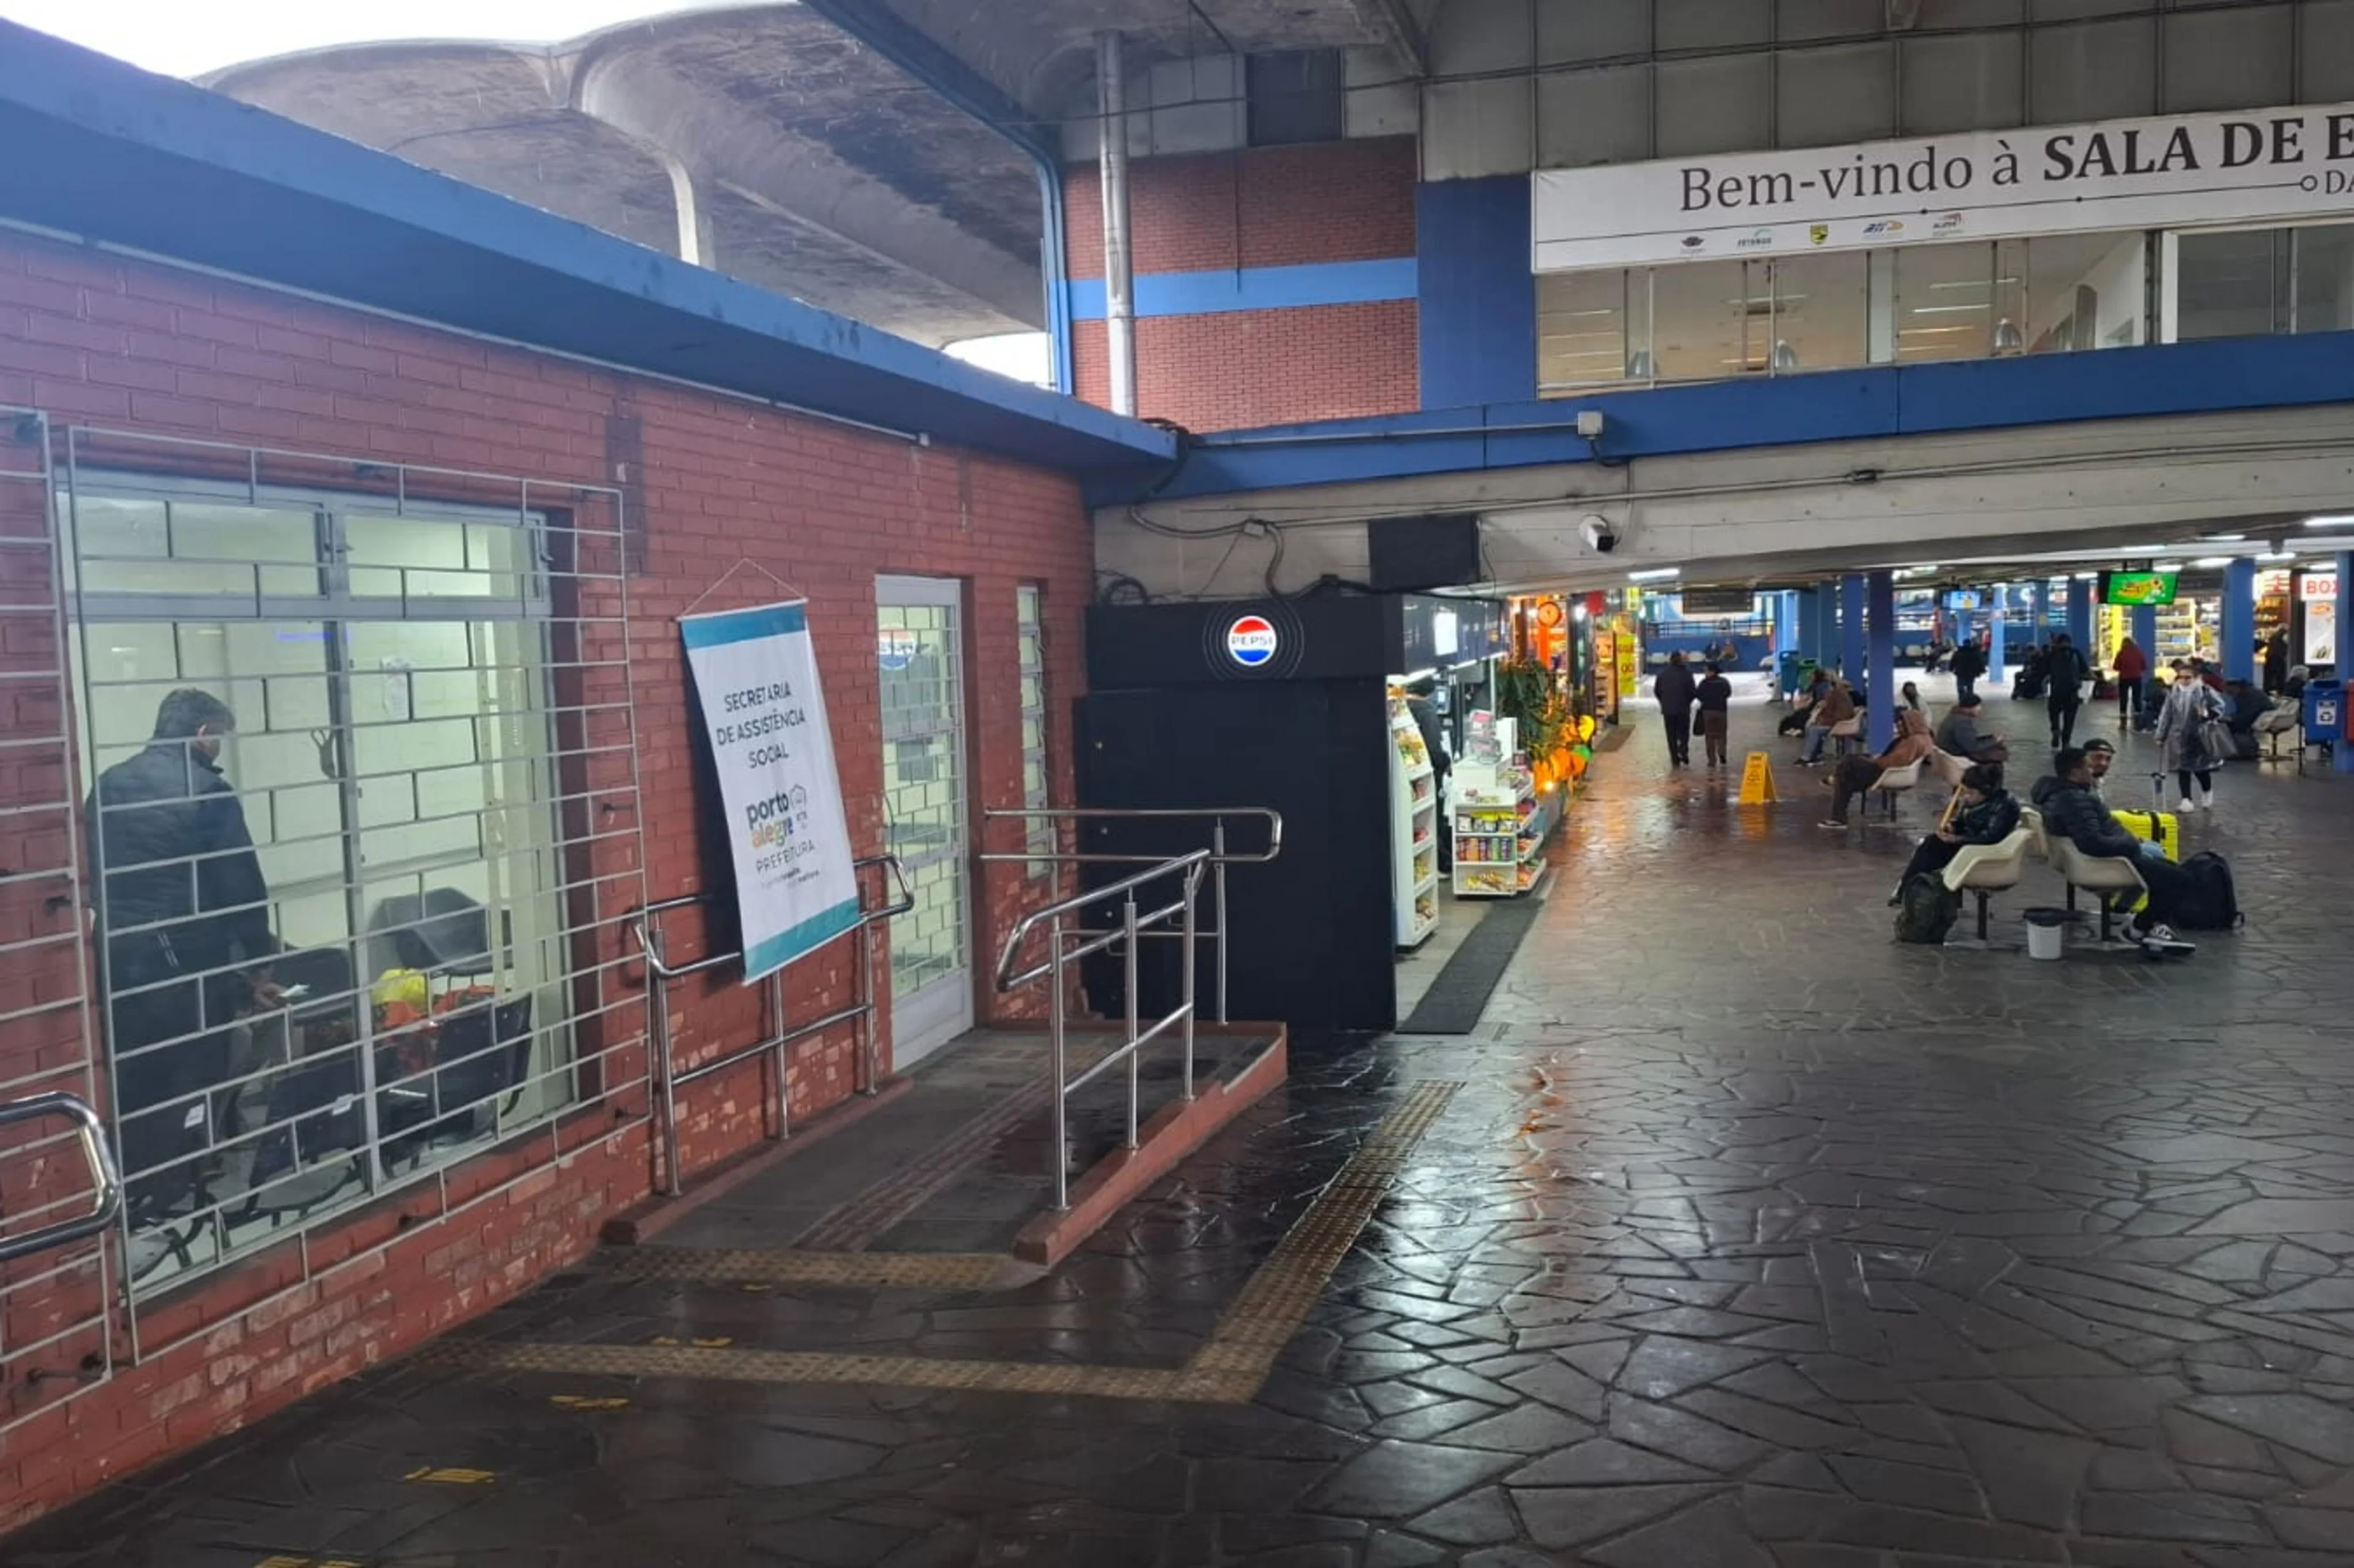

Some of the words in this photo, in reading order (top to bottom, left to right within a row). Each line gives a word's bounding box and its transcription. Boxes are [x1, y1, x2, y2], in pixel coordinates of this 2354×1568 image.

[1680, 146, 1972, 211] Bem-vindo
[1992, 139, 2020, 185] à
[2044, 126, 2201, 181] SALA
[2219, 117, 2304, 168] DE
[1232, 636, 1273, 645] PEPSI
[724, 681, 791, 712] SECRETARIA
[716, 726, 735, 746] DE
[748, 742, 790, 769] SOCIAL
[746, 791, 789, 830] porto
[752, 817, 794, 848] alegre
